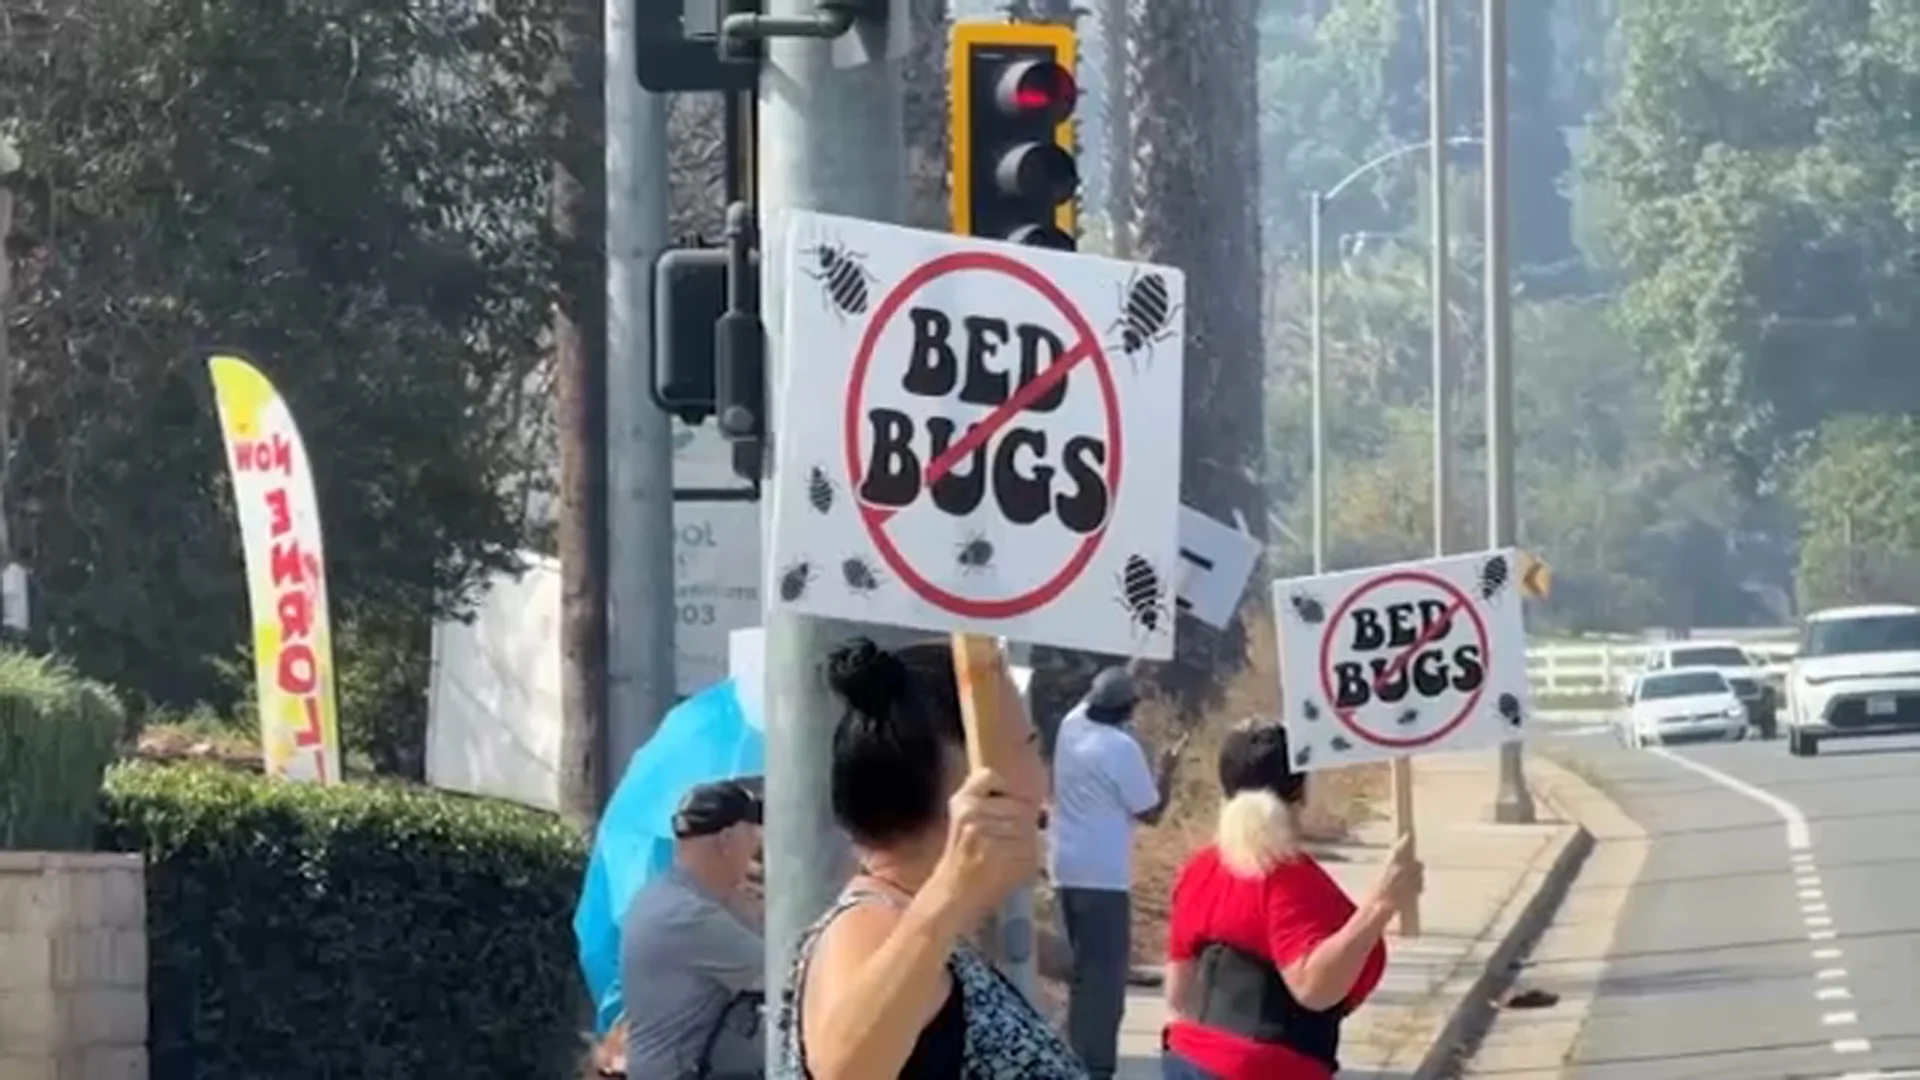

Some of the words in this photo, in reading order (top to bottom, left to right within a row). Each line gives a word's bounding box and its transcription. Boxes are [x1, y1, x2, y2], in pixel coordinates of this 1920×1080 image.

[902, 307, 1070, 413] BED
[860, 408, 1110, 535] BUGS
[1351, 600, 1453, 652] BED
[1334, 645, 1484, 709] BUGS
